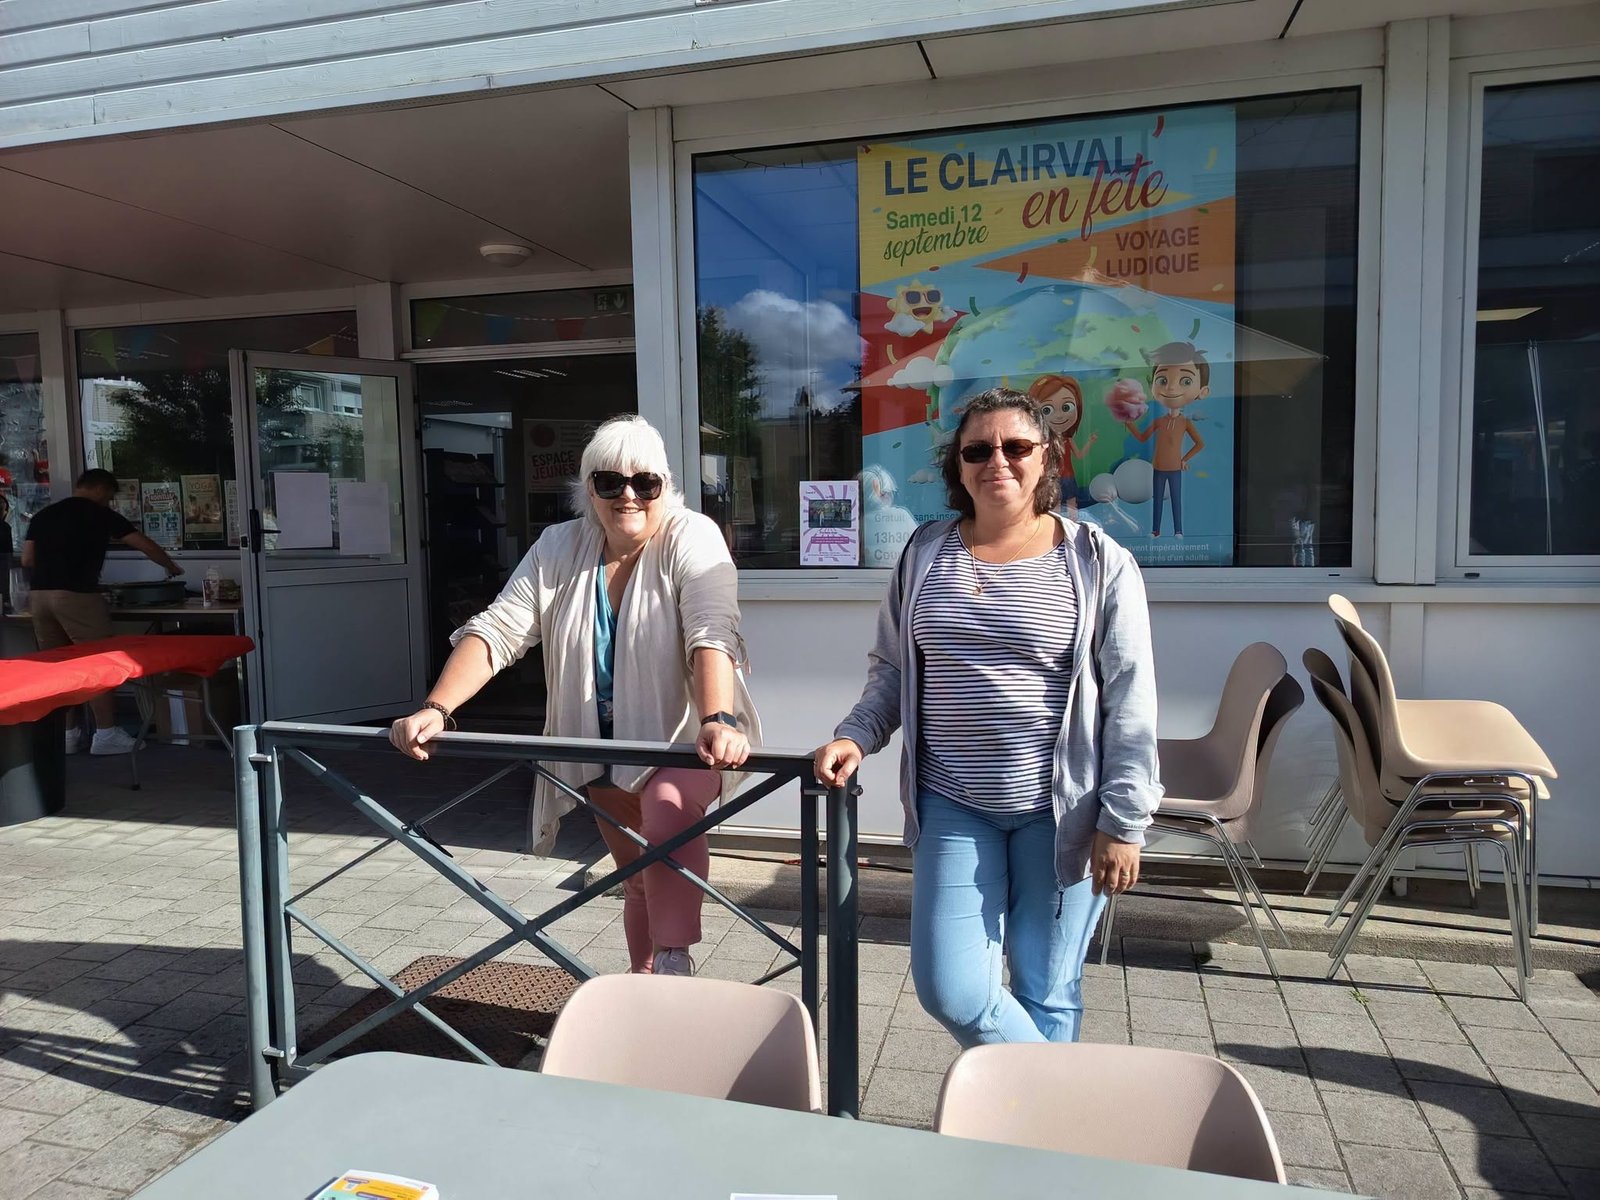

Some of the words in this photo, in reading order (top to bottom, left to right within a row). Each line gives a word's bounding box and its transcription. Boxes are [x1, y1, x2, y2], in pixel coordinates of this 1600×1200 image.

[884, 157, 929, 196] LE
[938, 135, 1136, 192] CLAIRVAL
[1021, 189, 1079, 230] en
[1080, 153, 1169, 241] fête
[886, 207, 956, 230] Samedi
[960, 203, 983, 223] 12
[883, 221, 989, 267] septembre
[1115, 226, 1200, 252] VOYAGE
[1105, 254, 1200, 278] LUDIQUE
[532, 451, 576, 467] ESPACE
[533, 464, 576, 480] JEUNES
[914, 512, 934, 522] sans
[1150, 544, 1209, 552] impérativement
[1185, 553, 1209, 561] adulte
